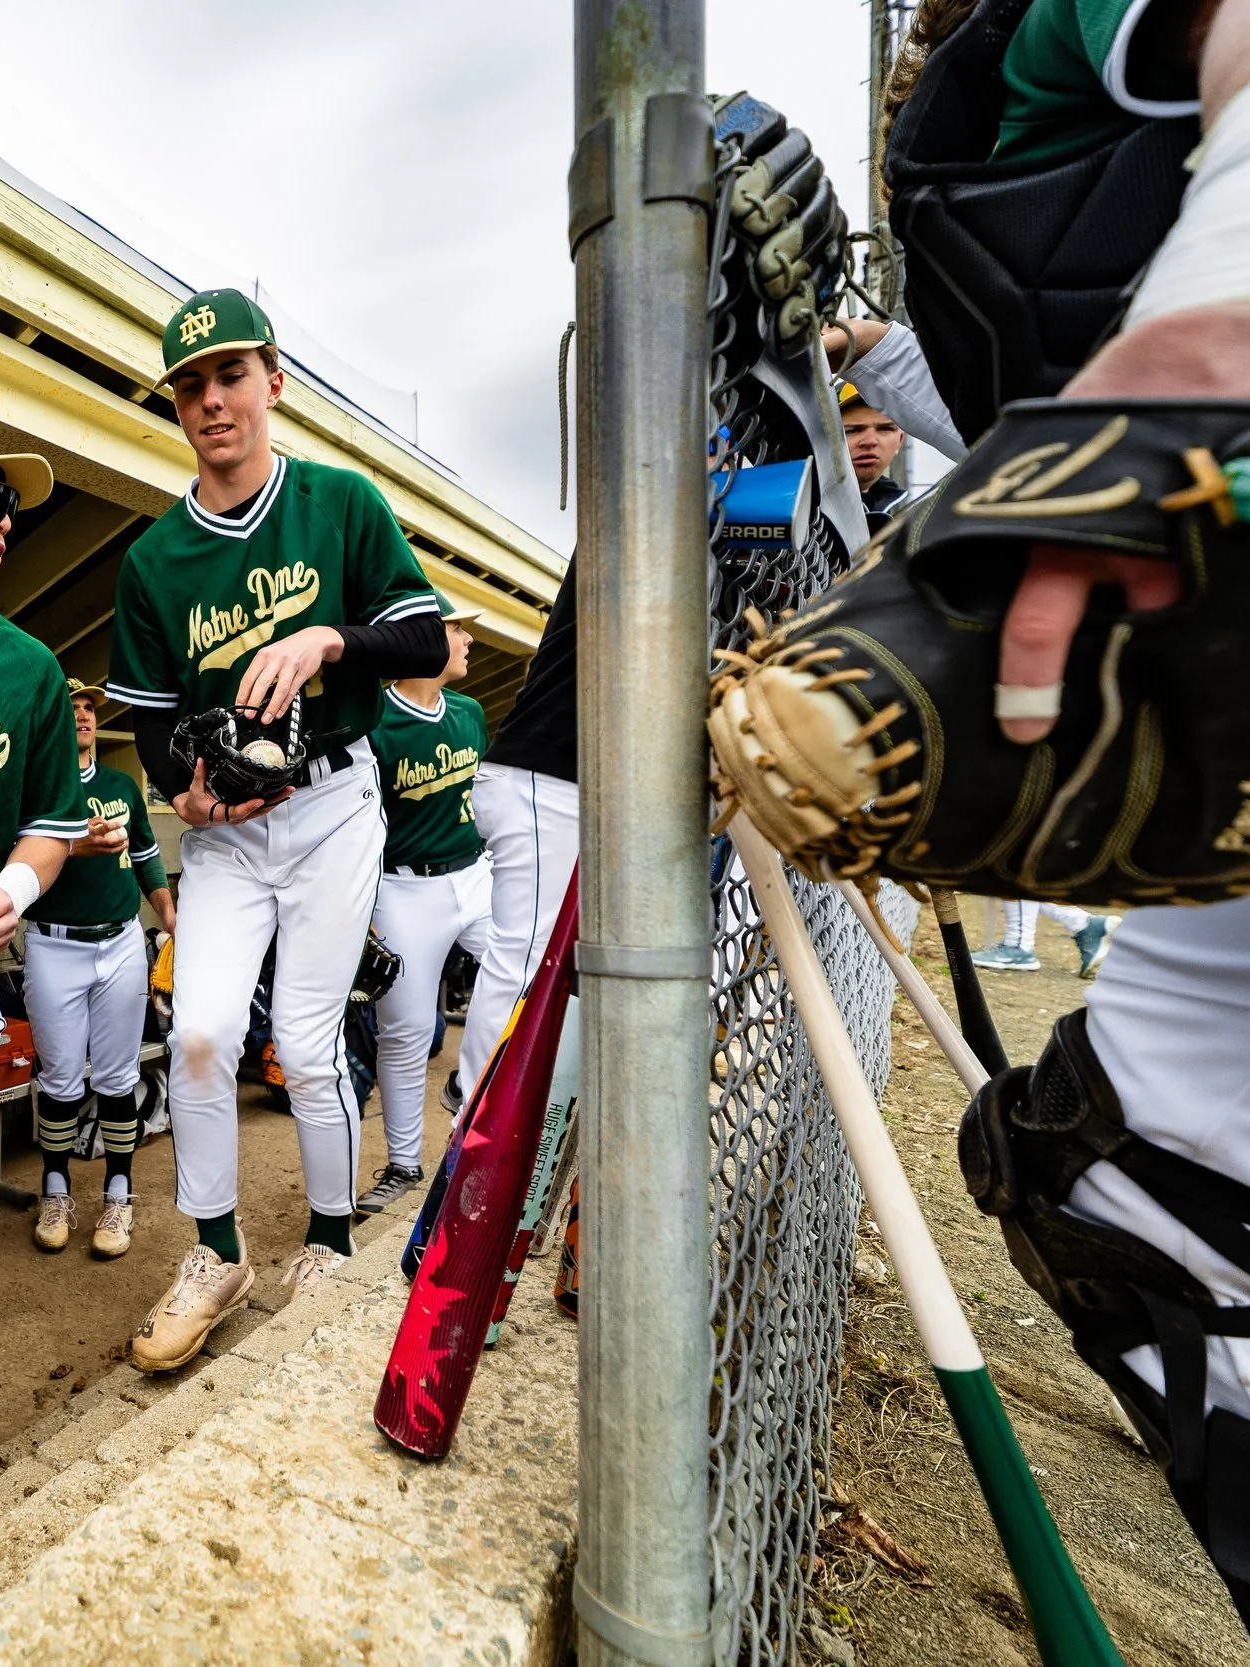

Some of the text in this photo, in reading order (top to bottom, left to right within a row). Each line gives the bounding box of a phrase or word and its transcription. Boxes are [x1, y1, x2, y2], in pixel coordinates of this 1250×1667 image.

[721, 526, 786, 539] ERADE
[187, 560, 309, 659] Notre Dme
[393, 743, 476, 791] Notre Dame
[87, 797, 127, 819] Dame
